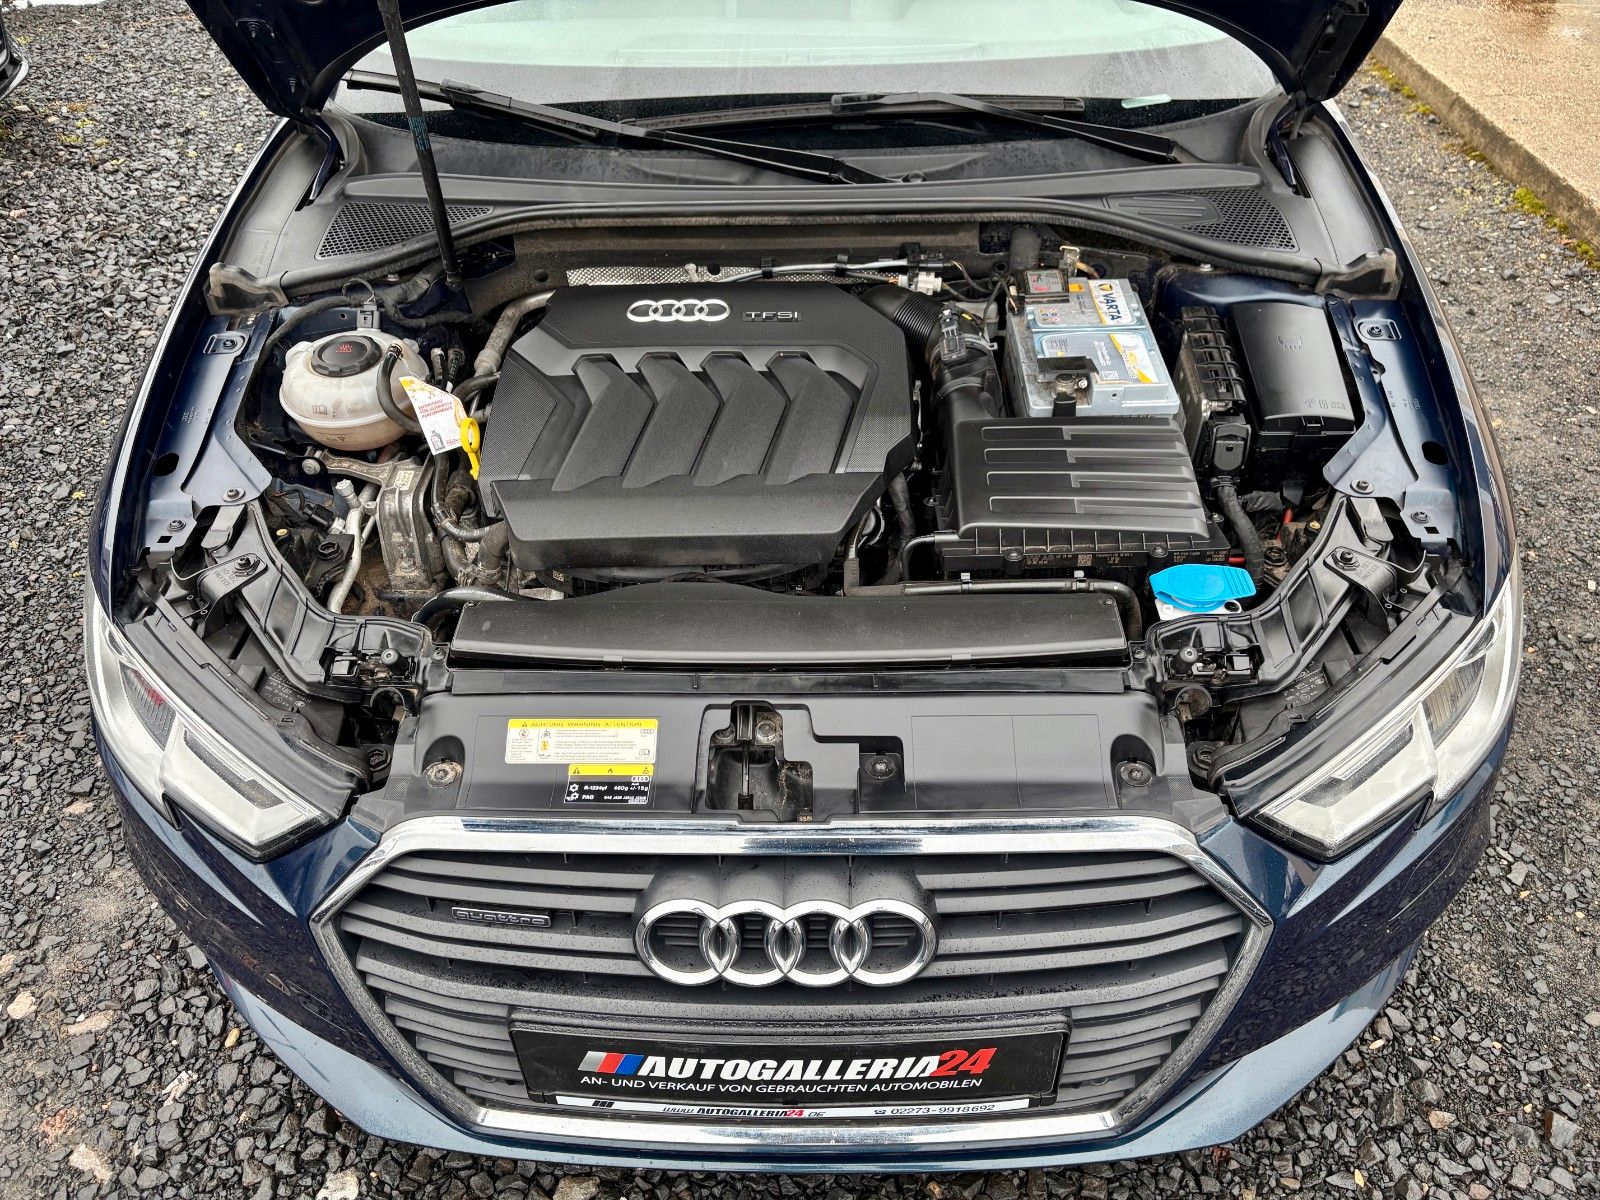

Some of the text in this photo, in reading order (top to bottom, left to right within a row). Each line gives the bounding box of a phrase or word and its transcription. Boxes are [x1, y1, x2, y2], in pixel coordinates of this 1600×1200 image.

[1102, 292, 1122, 321] VARTA
[745, 311, 799, 320] TFSI
[456, 910, 545, 924] quattro
[637, 1047, 998, 1081] AUTOGALLERIA24
[580, 1076, 983, 1094] AN- UND VERKAUF VON GEBRAUCHTEN AUTOMOBILEN
[890, 1104, 996, 1115] 02273-9918692
